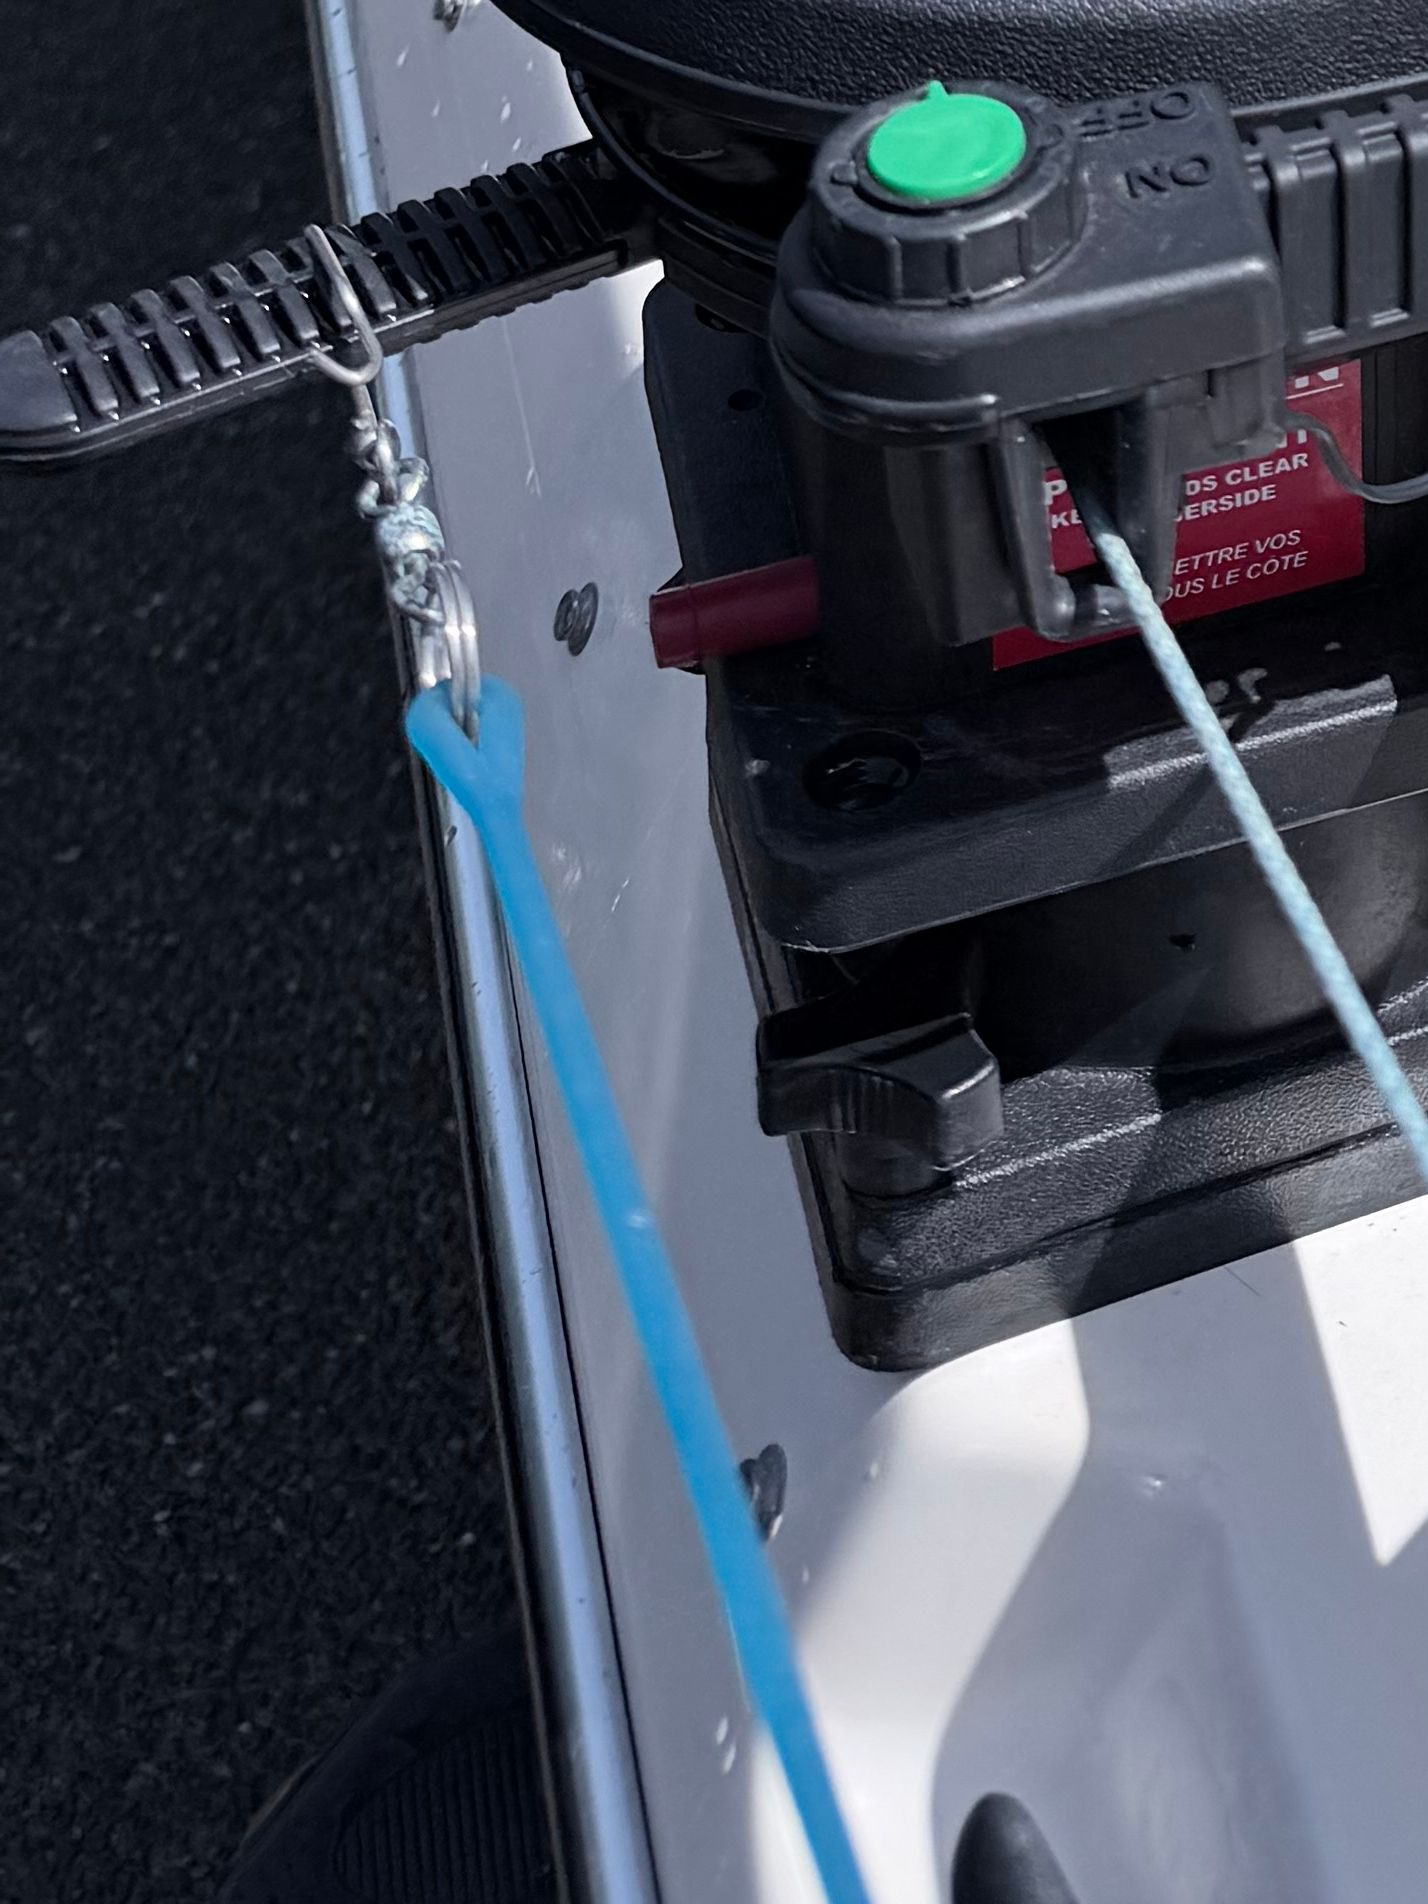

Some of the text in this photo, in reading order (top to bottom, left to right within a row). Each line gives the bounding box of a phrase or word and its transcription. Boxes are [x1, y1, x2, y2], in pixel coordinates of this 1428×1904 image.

[1080, 92, 1195, 138] OFF
[1125, 155, 1214, 200] ON
[1225, 452, 1310, 487] CLEAR
[1173, 483, 1277, 523] ERSIDE
[1173, 529, 1302, 576] ETTRE VOS
[1211, 568, 1241, 590] LE
